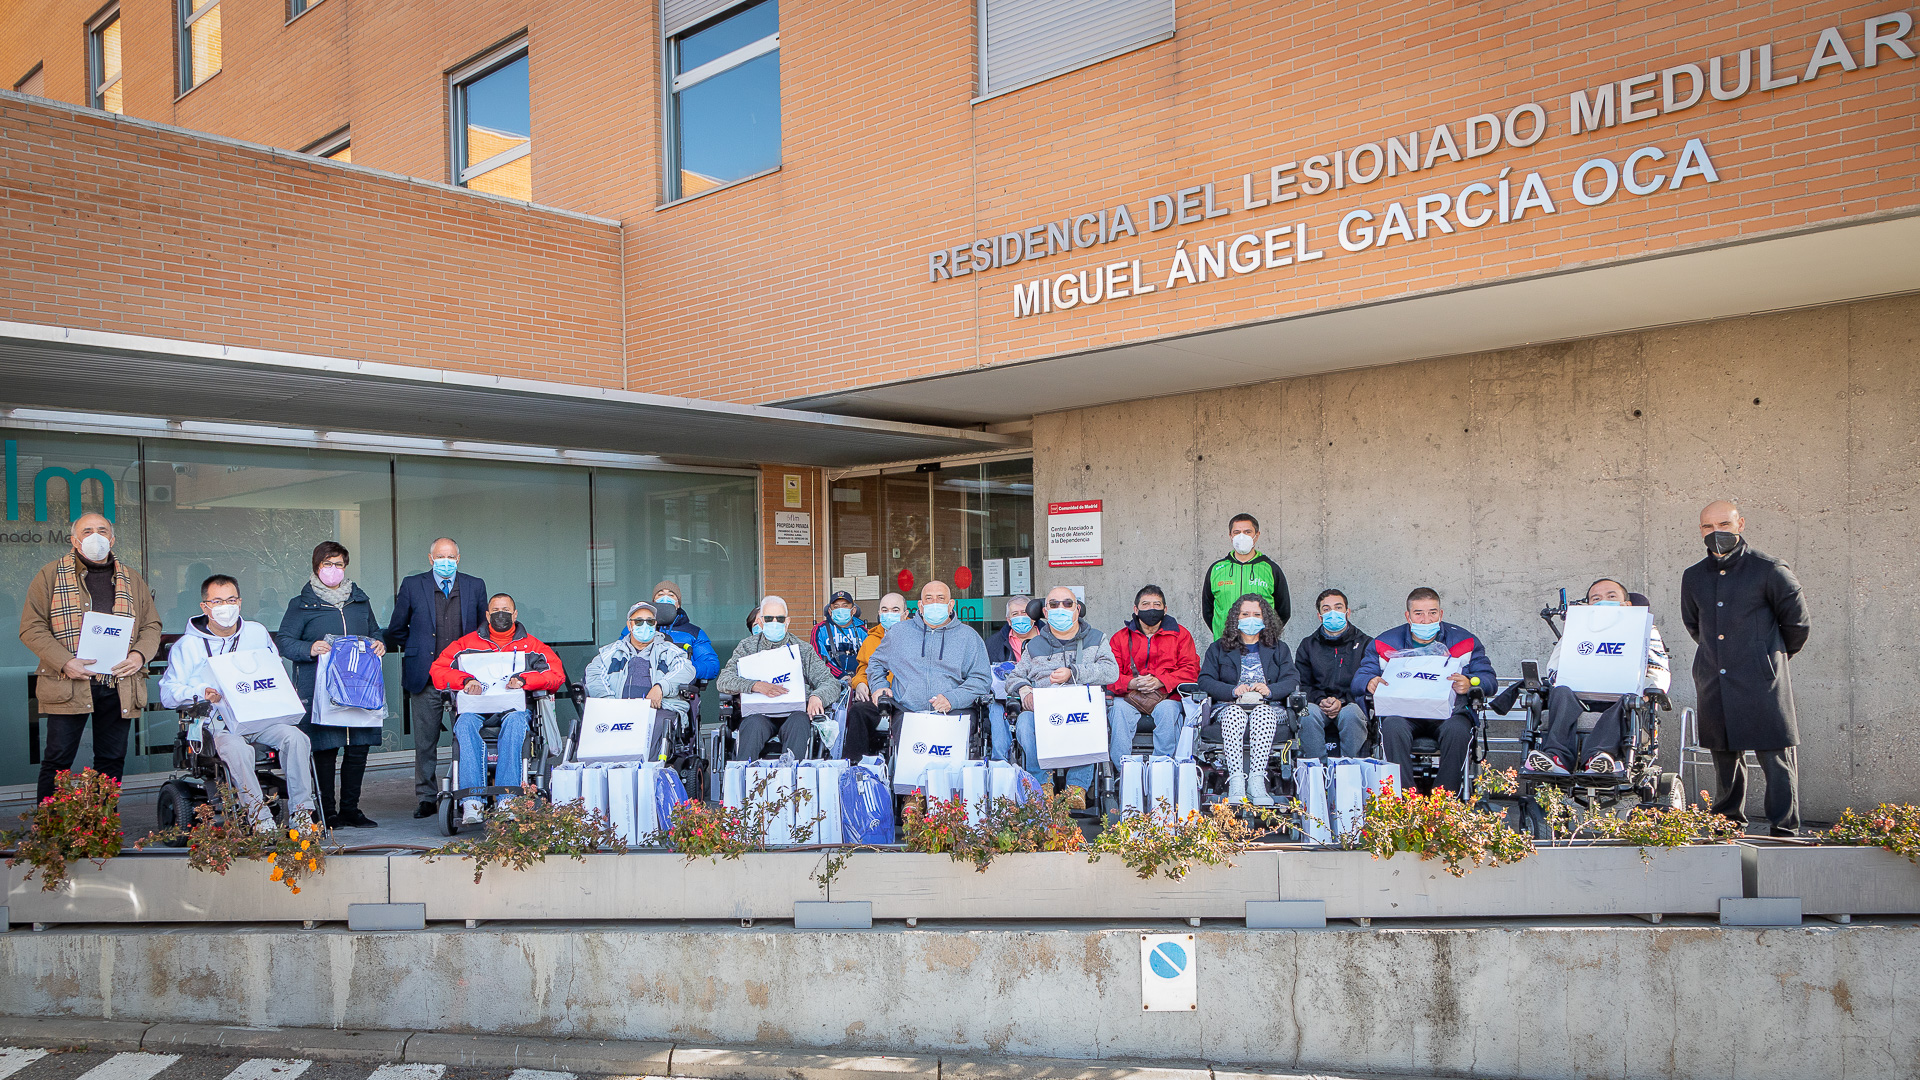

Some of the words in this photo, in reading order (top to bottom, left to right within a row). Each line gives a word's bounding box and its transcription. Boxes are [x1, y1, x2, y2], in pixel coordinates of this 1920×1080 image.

[928, 204, 1137, 283] RESIDENCIA
[1148, 182, 1230, 232] DEL
[1243, 102, 1547, 211] LESIONADO
[1570, 10, 1917, 136] MEDULAR
[1013, 259, 1156, 318] MIGUEL
[1166, 222, 1324, 289] ÁNGEL
[1337, 167, 1556, 252] GARCÍA
[1572, 137, 1721, 206] OCA
[103, 626, 122, 637] AFE
[1595, 642, 1626, 654] AFE
[771, 672, 791, 684] AFE
[1412, 671, 1441, 681] AFE
[253, 677, 276, 691] AFE
[1065, 712, 1090, 724] AFE
[610, 722, 635, 731] AFE
[928, 744, 953, 756] AFE
